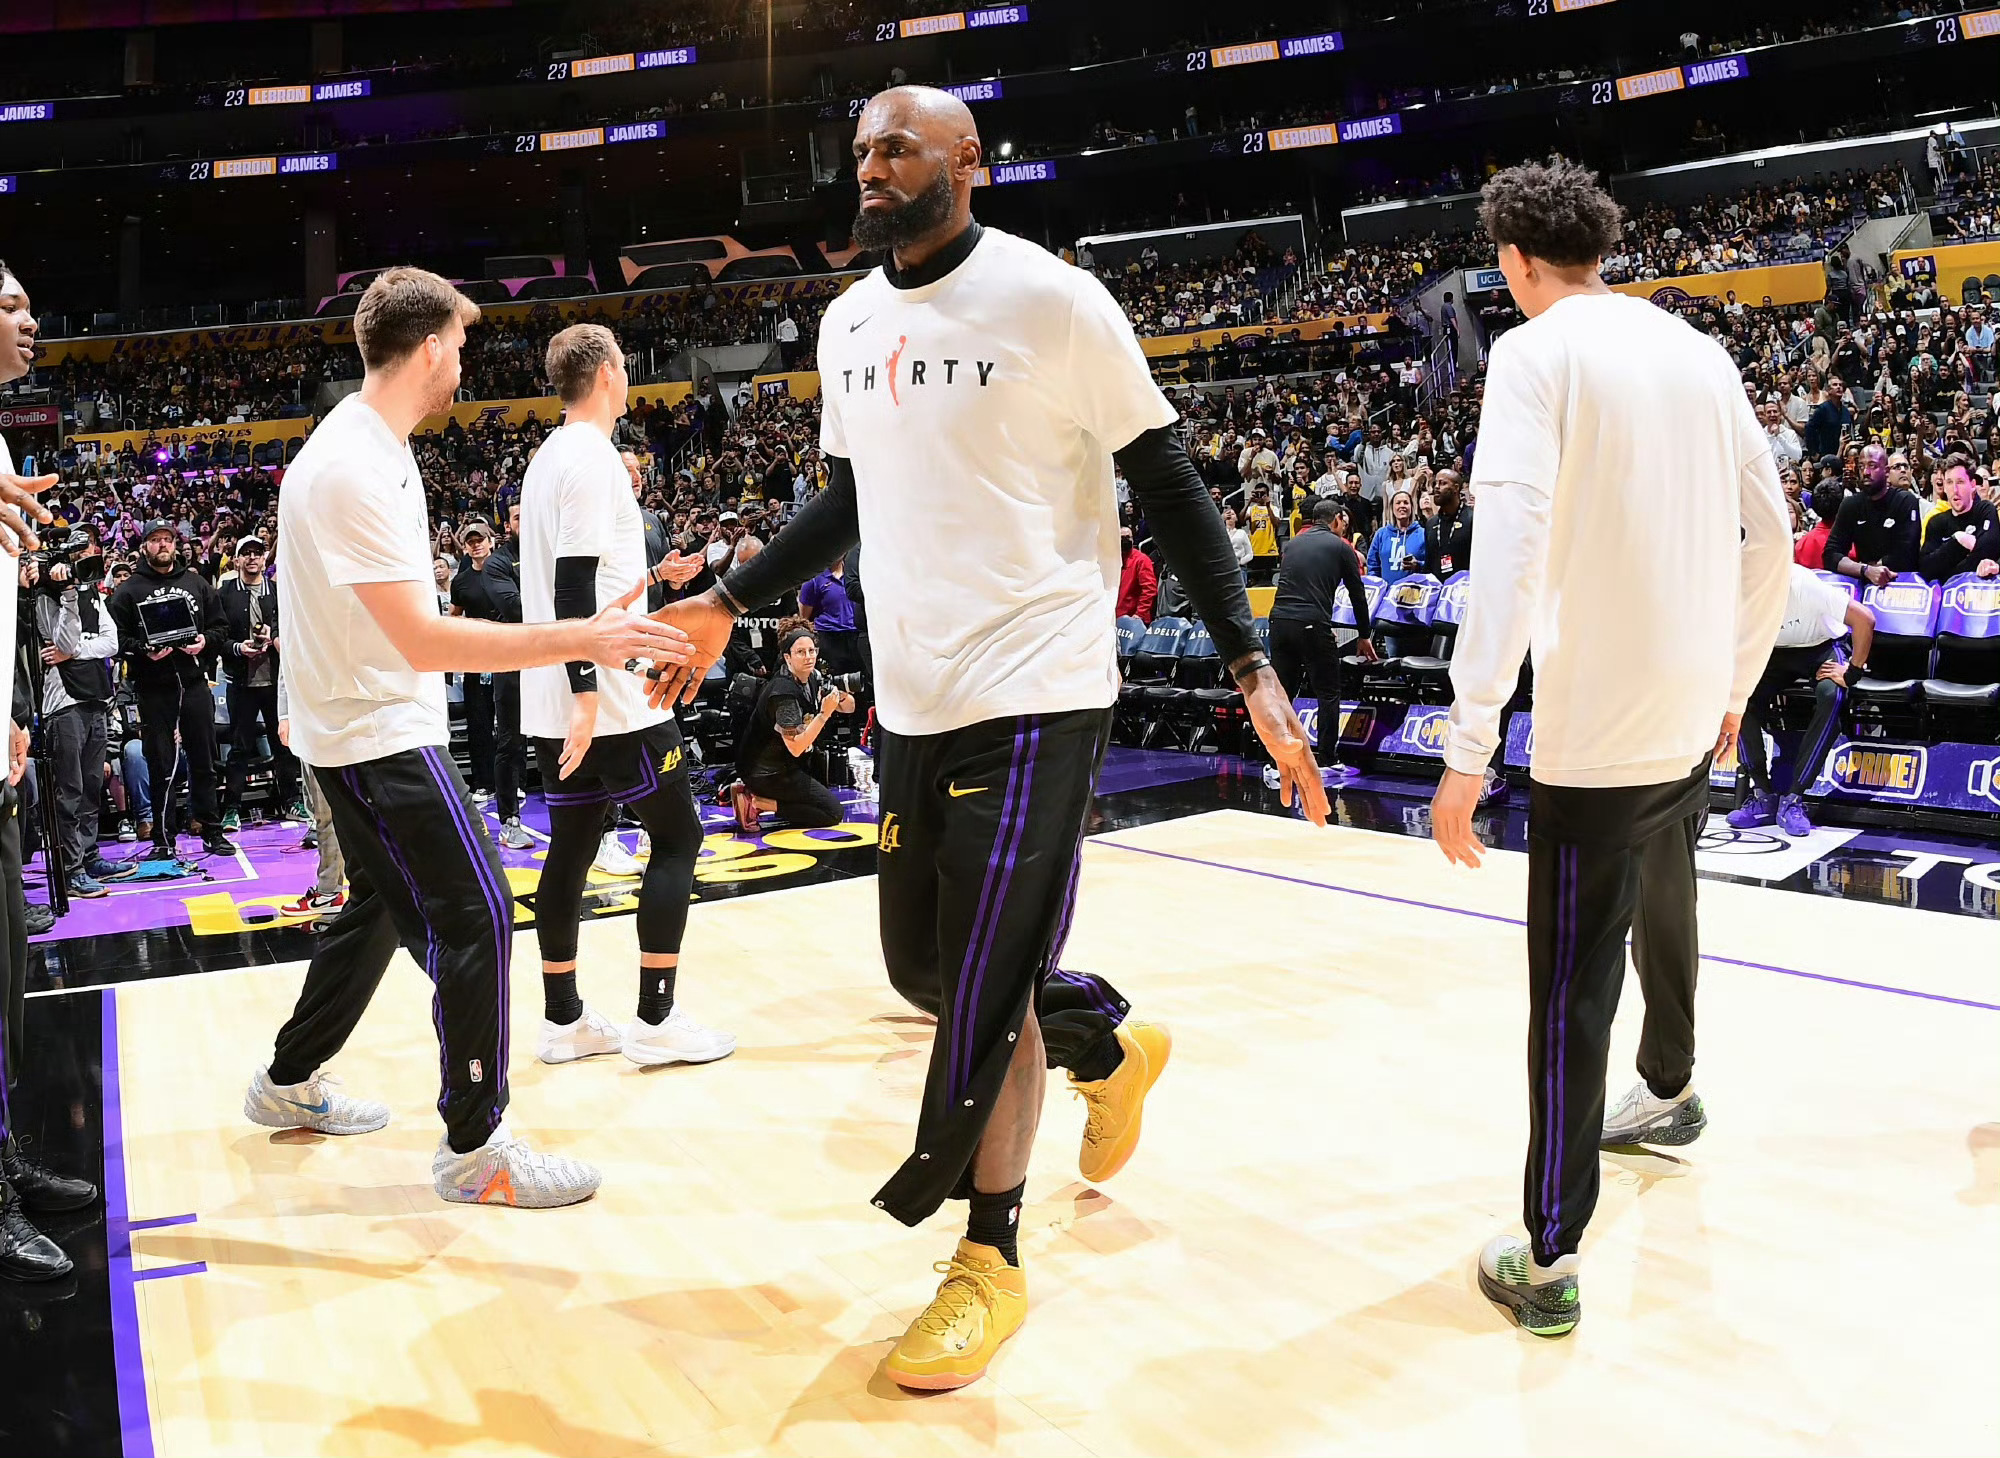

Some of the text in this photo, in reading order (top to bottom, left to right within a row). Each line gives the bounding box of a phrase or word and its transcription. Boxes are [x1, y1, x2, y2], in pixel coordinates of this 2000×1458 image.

[875, 8, 1020, 42] 23 LEBRON JAMES
[1936, 17, 1957, 44] 23
[547, 49, 688, 80] 23 LEBRON JAMES
[1186, 35, 1335, 72] 23 LEBRON JAMES
[224, 82, 362, 107] 23 LEBRON JAMES
[1592, 62, 1740, 104] 23 LEBRON JAMES
[0, 105, 46, 121] JAMES
[515, 123, 658, 153] 23 LEBRON JAMES
[1243, 117, 1393, 154] 23 LEBRON JAMES
[189, 156, 329, 180] 23 LEBRON JAMES
[995, 164, 1047, 183] JAMES
[718, 277, 843, 305] NGELES
[1480, 274, 1504, 285] UCLA
[762, 381, 784, 395] 117
[15, 411, 47, 423] twilio
[1389, 537, 1407, 571] LA
[153, 586, 200, 612] OF ANGELS
[737, 616, 780, 629] HOTO
[1153, 627, 1180, 637] DELTA
[1844, 751, 1912, 789] PRIME
